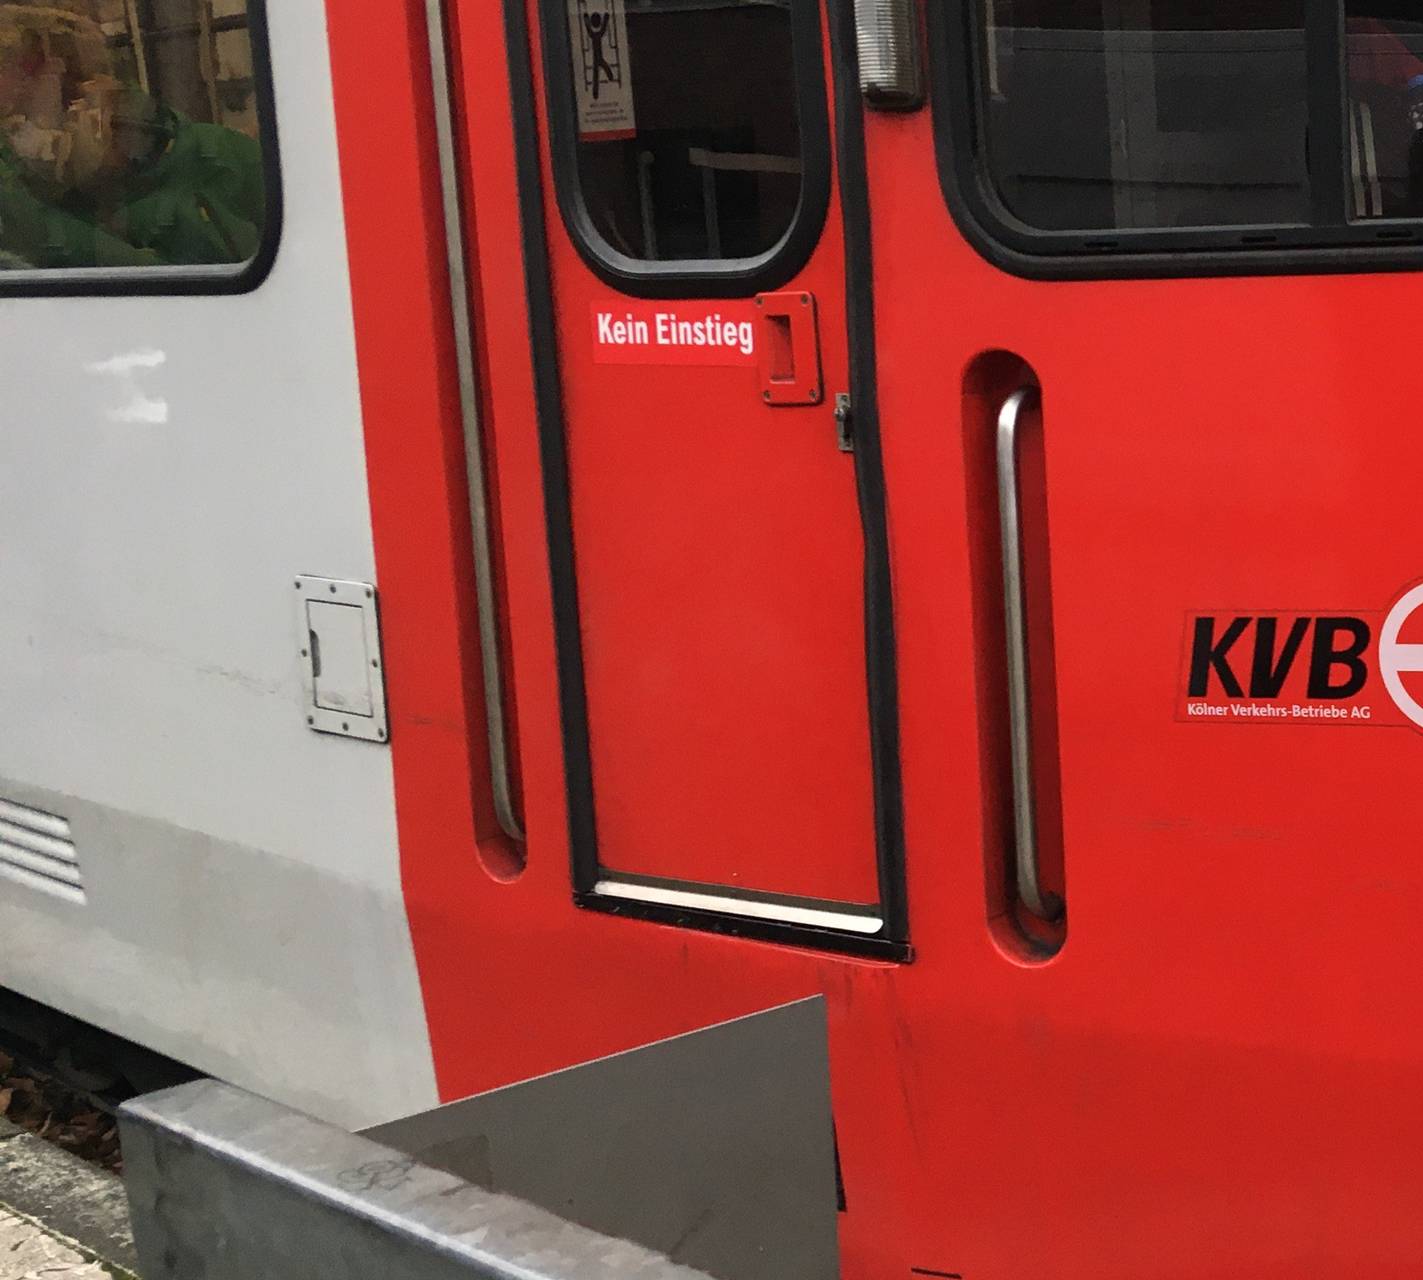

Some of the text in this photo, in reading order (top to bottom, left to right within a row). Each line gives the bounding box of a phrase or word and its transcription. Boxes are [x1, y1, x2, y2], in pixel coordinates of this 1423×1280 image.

[597, 313, 754, 355] Kein Einstieg
[1187, 616, 1371, 700] KVB
[1188, 703, 1371, 719] Kölner Verkehrs-Betriebe AG
